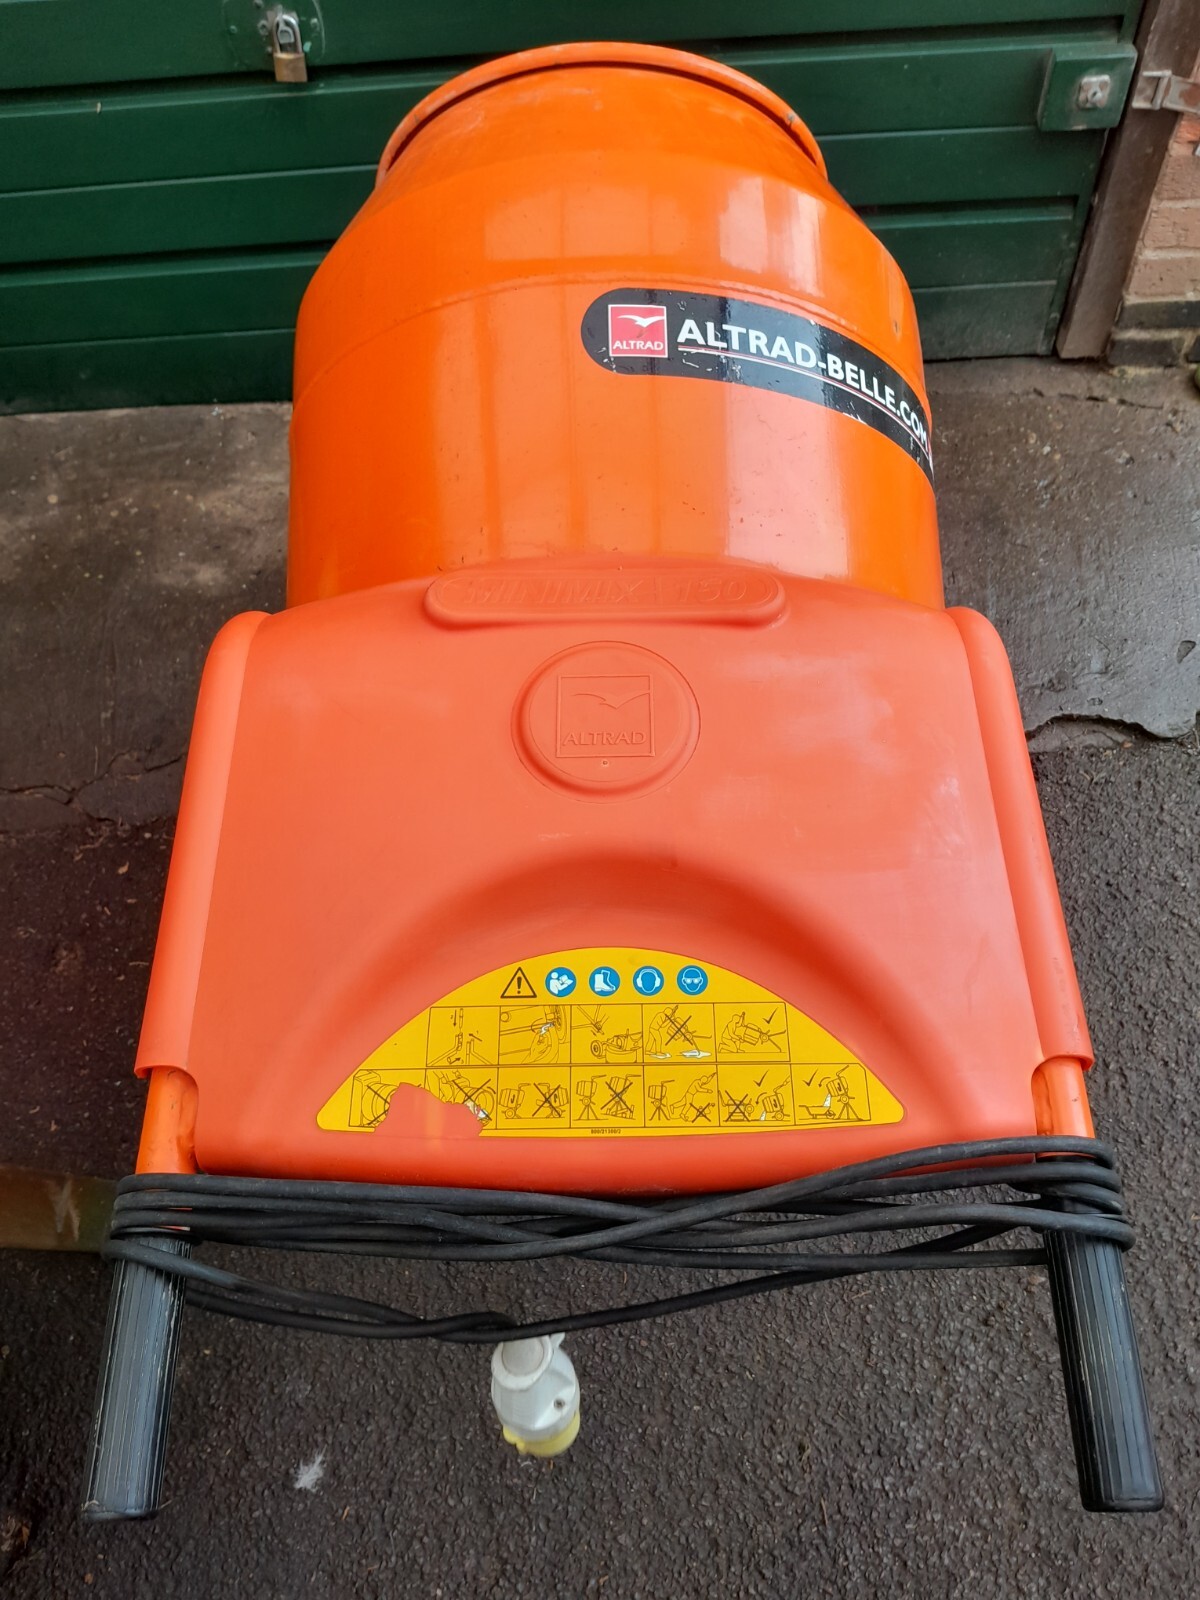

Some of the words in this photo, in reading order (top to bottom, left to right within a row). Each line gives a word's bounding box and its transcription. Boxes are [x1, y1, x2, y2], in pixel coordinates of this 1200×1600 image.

[613, 339, 664, 351] ALTRAD
[677, 319, 928, 453] ALTRAD-BELLE.COM
[676, 577, 748, 603] 150
[562, 730, 647, 747] ALTRAD
